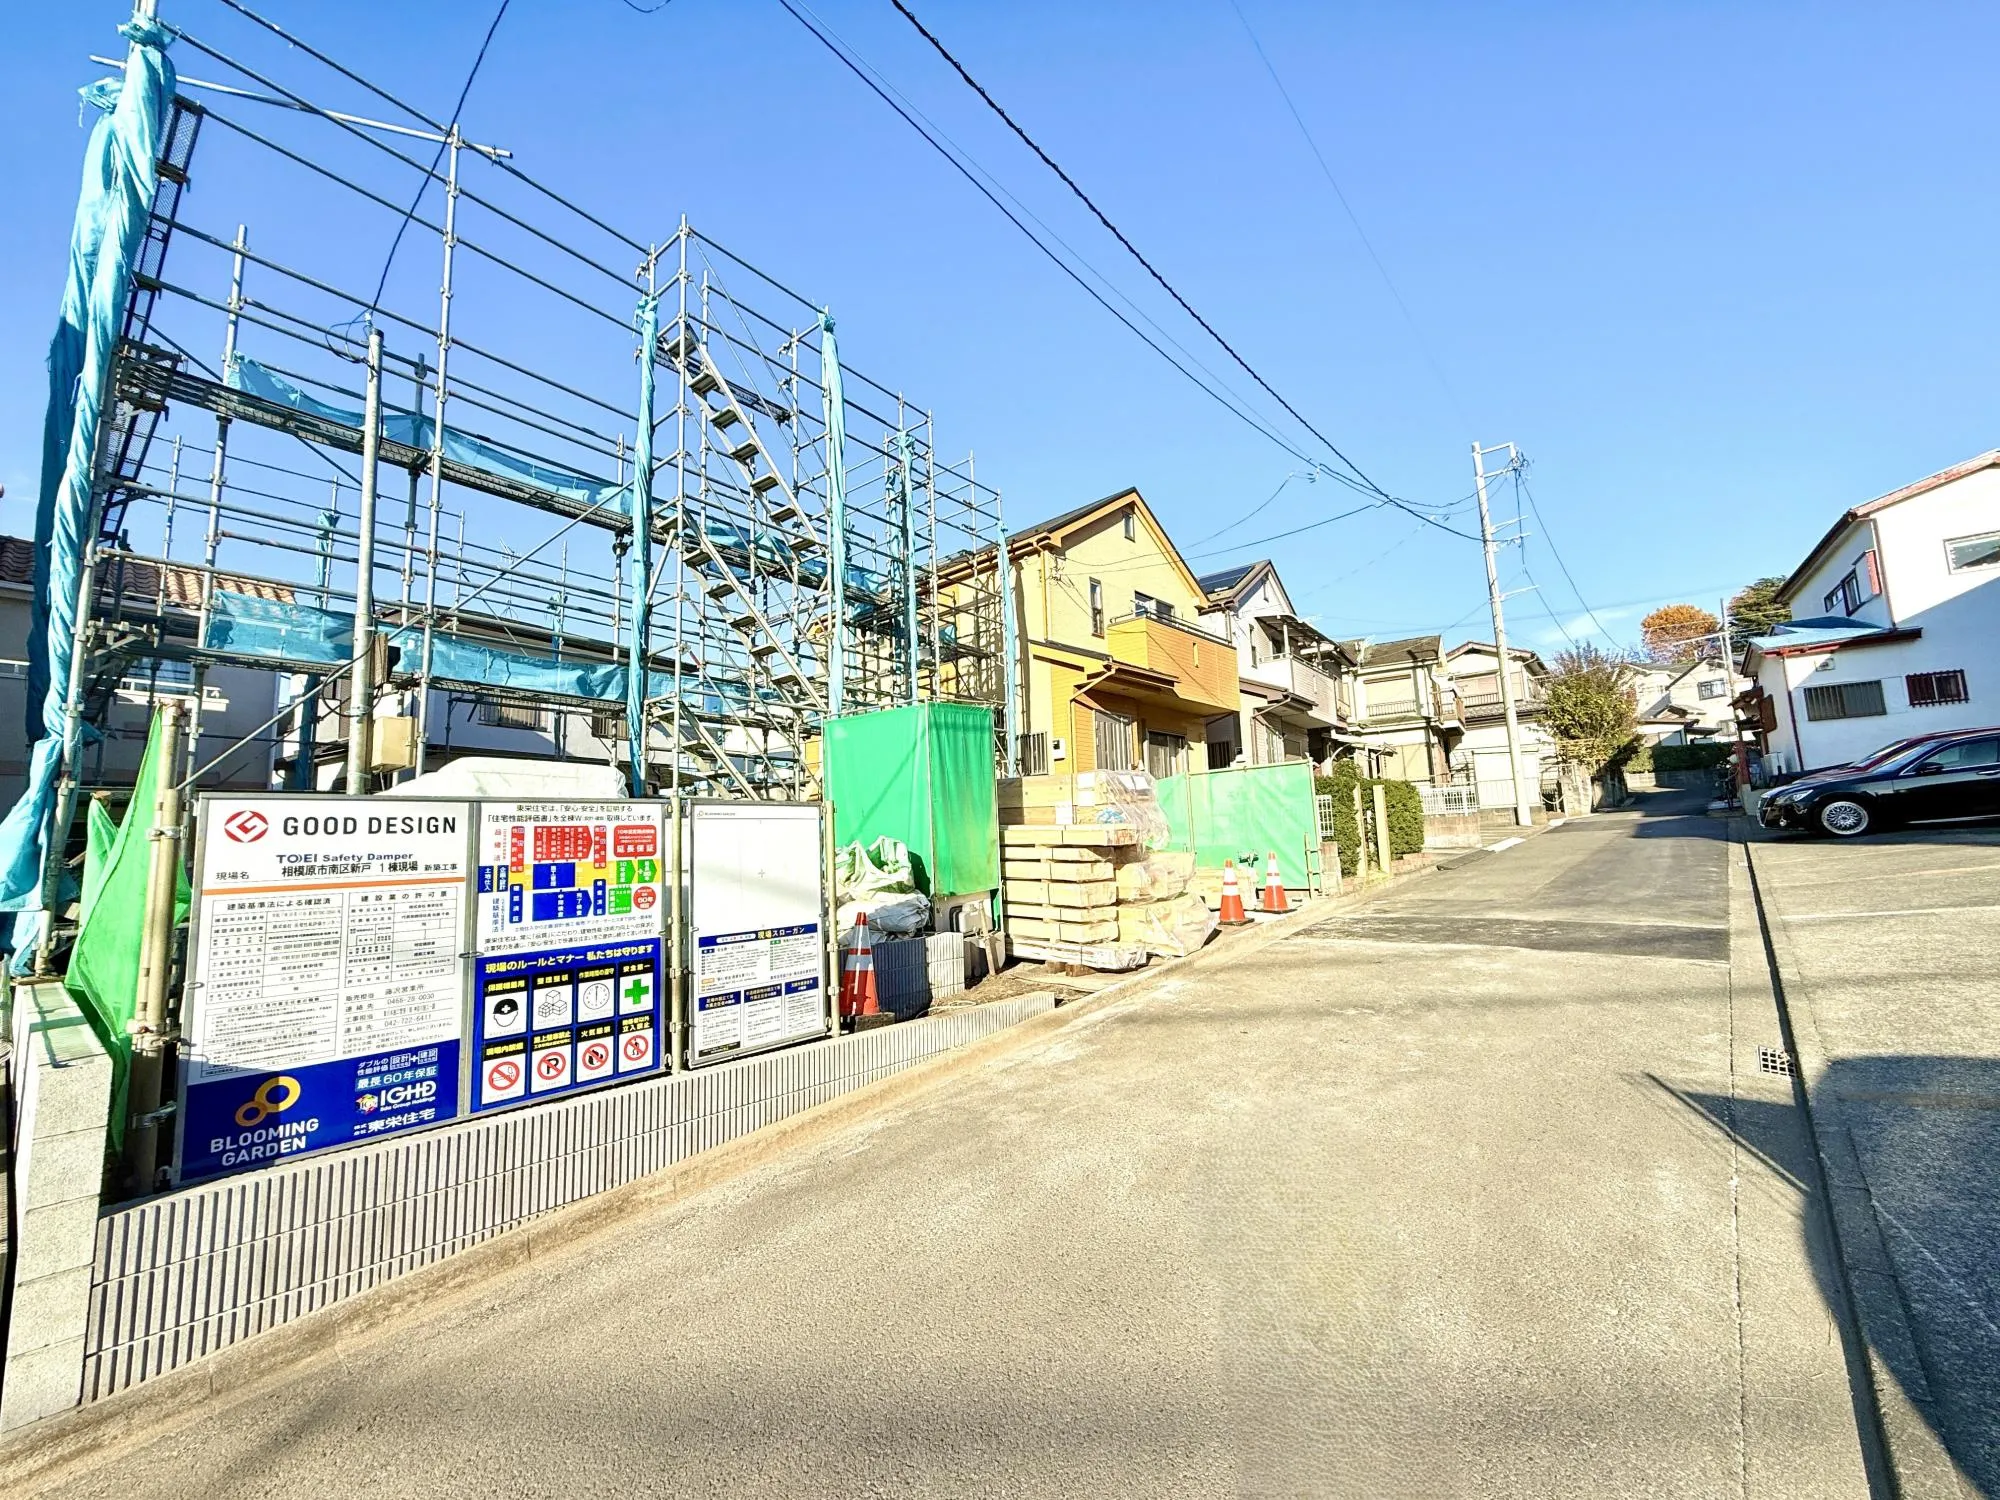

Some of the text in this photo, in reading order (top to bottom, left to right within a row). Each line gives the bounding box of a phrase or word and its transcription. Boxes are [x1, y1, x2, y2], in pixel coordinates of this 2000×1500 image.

[283, 816, 457, 836] GOOD DESIGN
[322, 854, 363, 863] Safety
[367, 853, 414, 862] Damper
[216, 871, 249, 880] 現場名
[281, 862, 372, 877] 相模原市南区新戸
[424, 863, 458, 871] 新築工事
[485, 944, 654, 974] 現場のルールとマナー 私たちは守ります
[358, 1057, 389, 1069] ダブルの
[367, 1107, 436, 1134] 東栄住宅
[210, 1117, 319, 1154] BLOOMING
[221, 1135, 307, 1167] GARDEN
